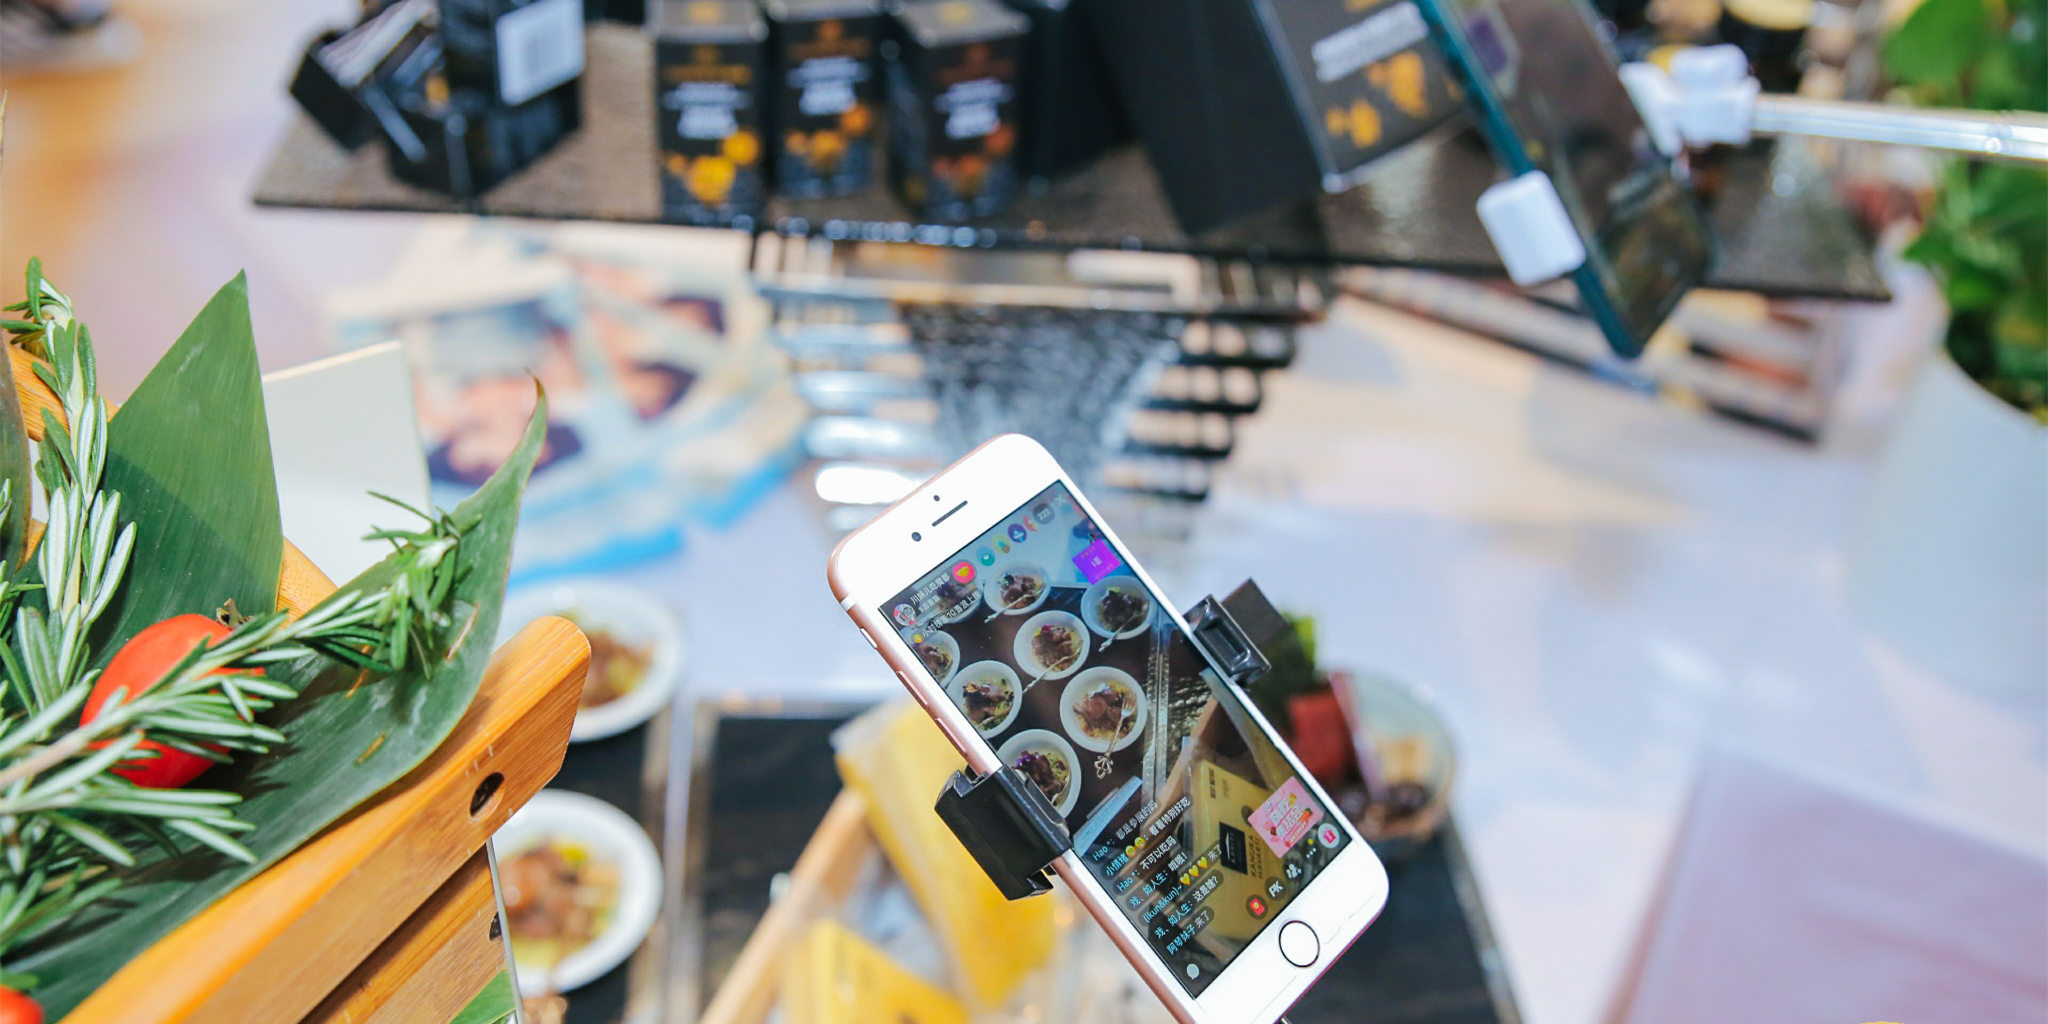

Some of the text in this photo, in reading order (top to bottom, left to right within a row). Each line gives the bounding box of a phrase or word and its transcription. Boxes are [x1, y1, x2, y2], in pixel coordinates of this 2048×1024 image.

[1092, 845, 1109, 861] Hao
[1116, 877, 1133, 892] Hao
[1268, 880, 1284, 898] PK
